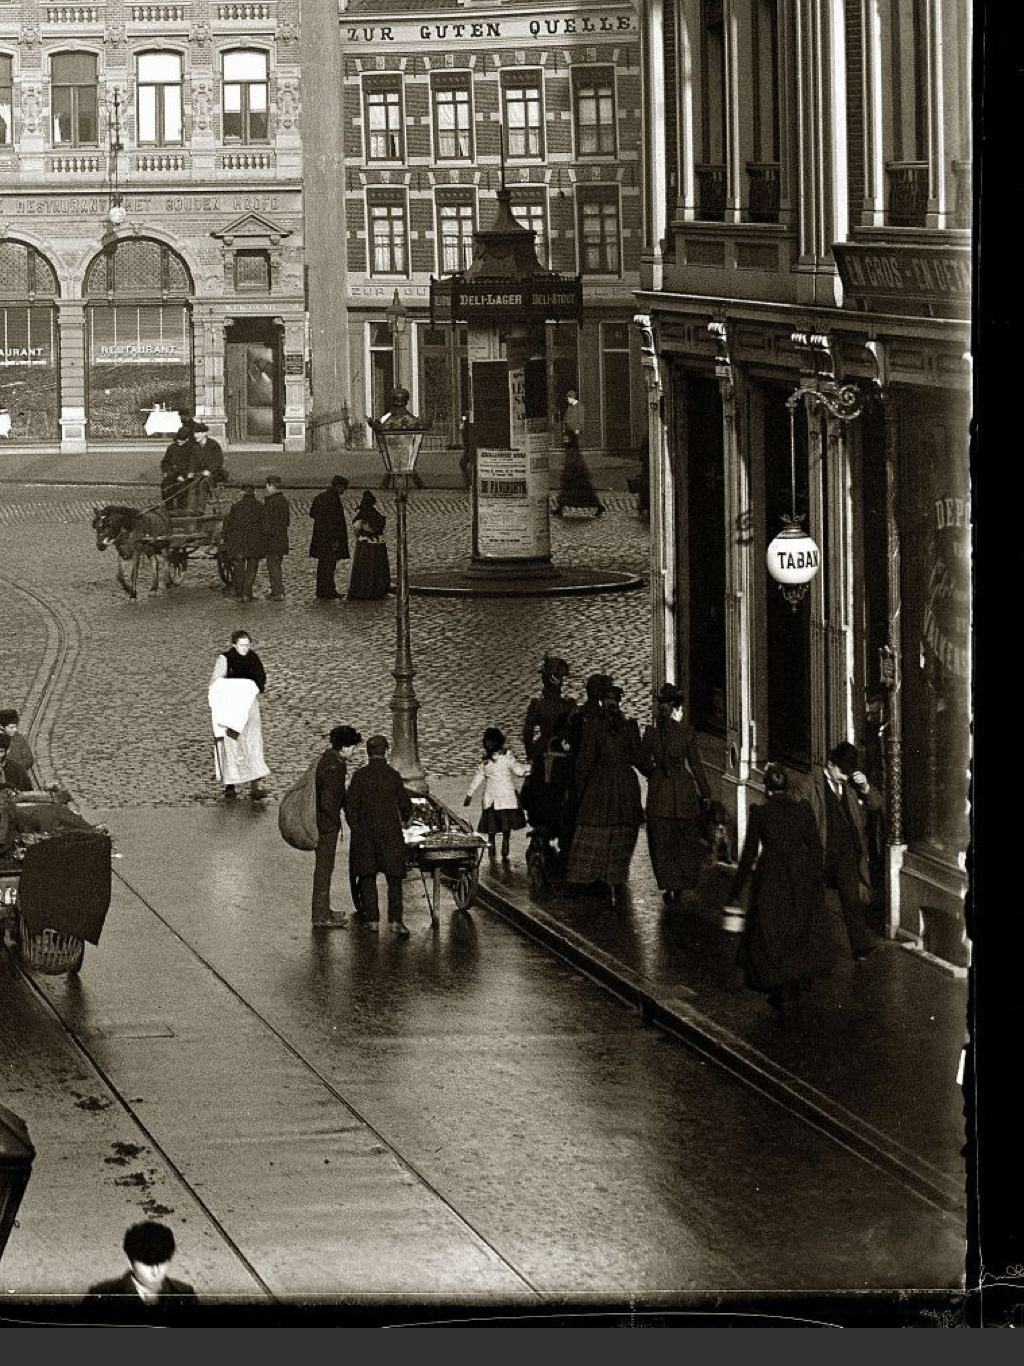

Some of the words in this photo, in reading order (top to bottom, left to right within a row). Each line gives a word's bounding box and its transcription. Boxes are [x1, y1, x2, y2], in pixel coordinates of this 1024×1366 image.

[347, 27, 395, 42] ZUR
[420, 22, 502, 39] GUTEN
[165, 196, 220, 212] GOUDEN
[100, 345, 177, 355] RESTAURANT
